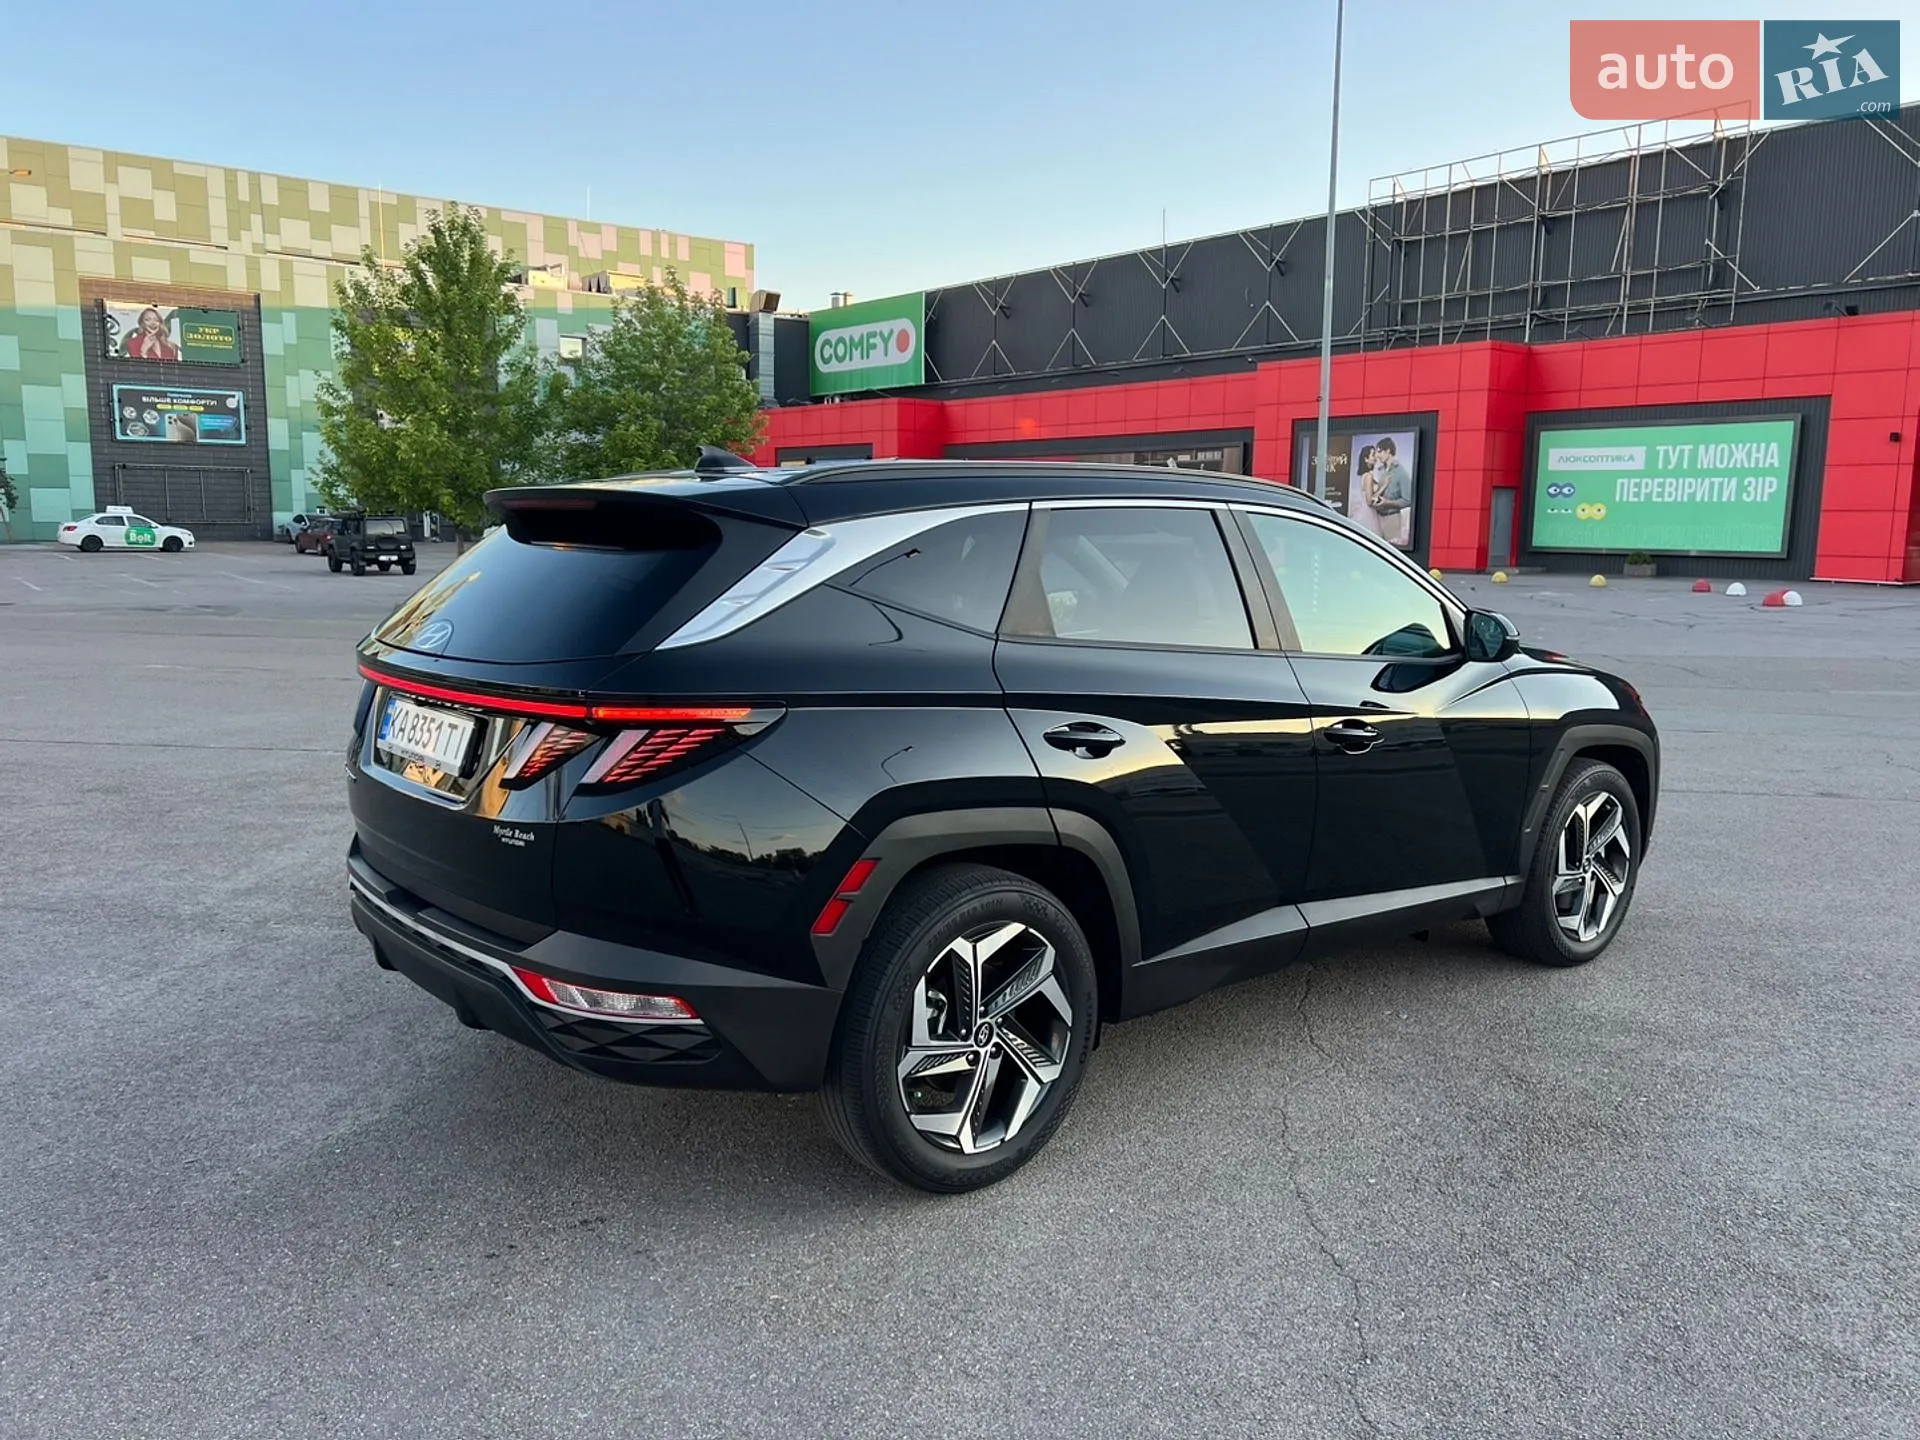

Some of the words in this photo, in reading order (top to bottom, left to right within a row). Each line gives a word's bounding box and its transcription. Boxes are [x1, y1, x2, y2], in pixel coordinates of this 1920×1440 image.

[820, 328, 894, 365] COMFY
[1558, 454, 1635, 464] ЛЮКСОПТИКА
[1656, 444, 1694, 470] ТУТ
[1697, 442, 1779, 469] МОЖНА
[1615, 477, 1738, 502] ПЕРЕВІРИТИ
[1742, 476, 1777, 502] ЗІР
[130, 530, 152, 543] Bolt
